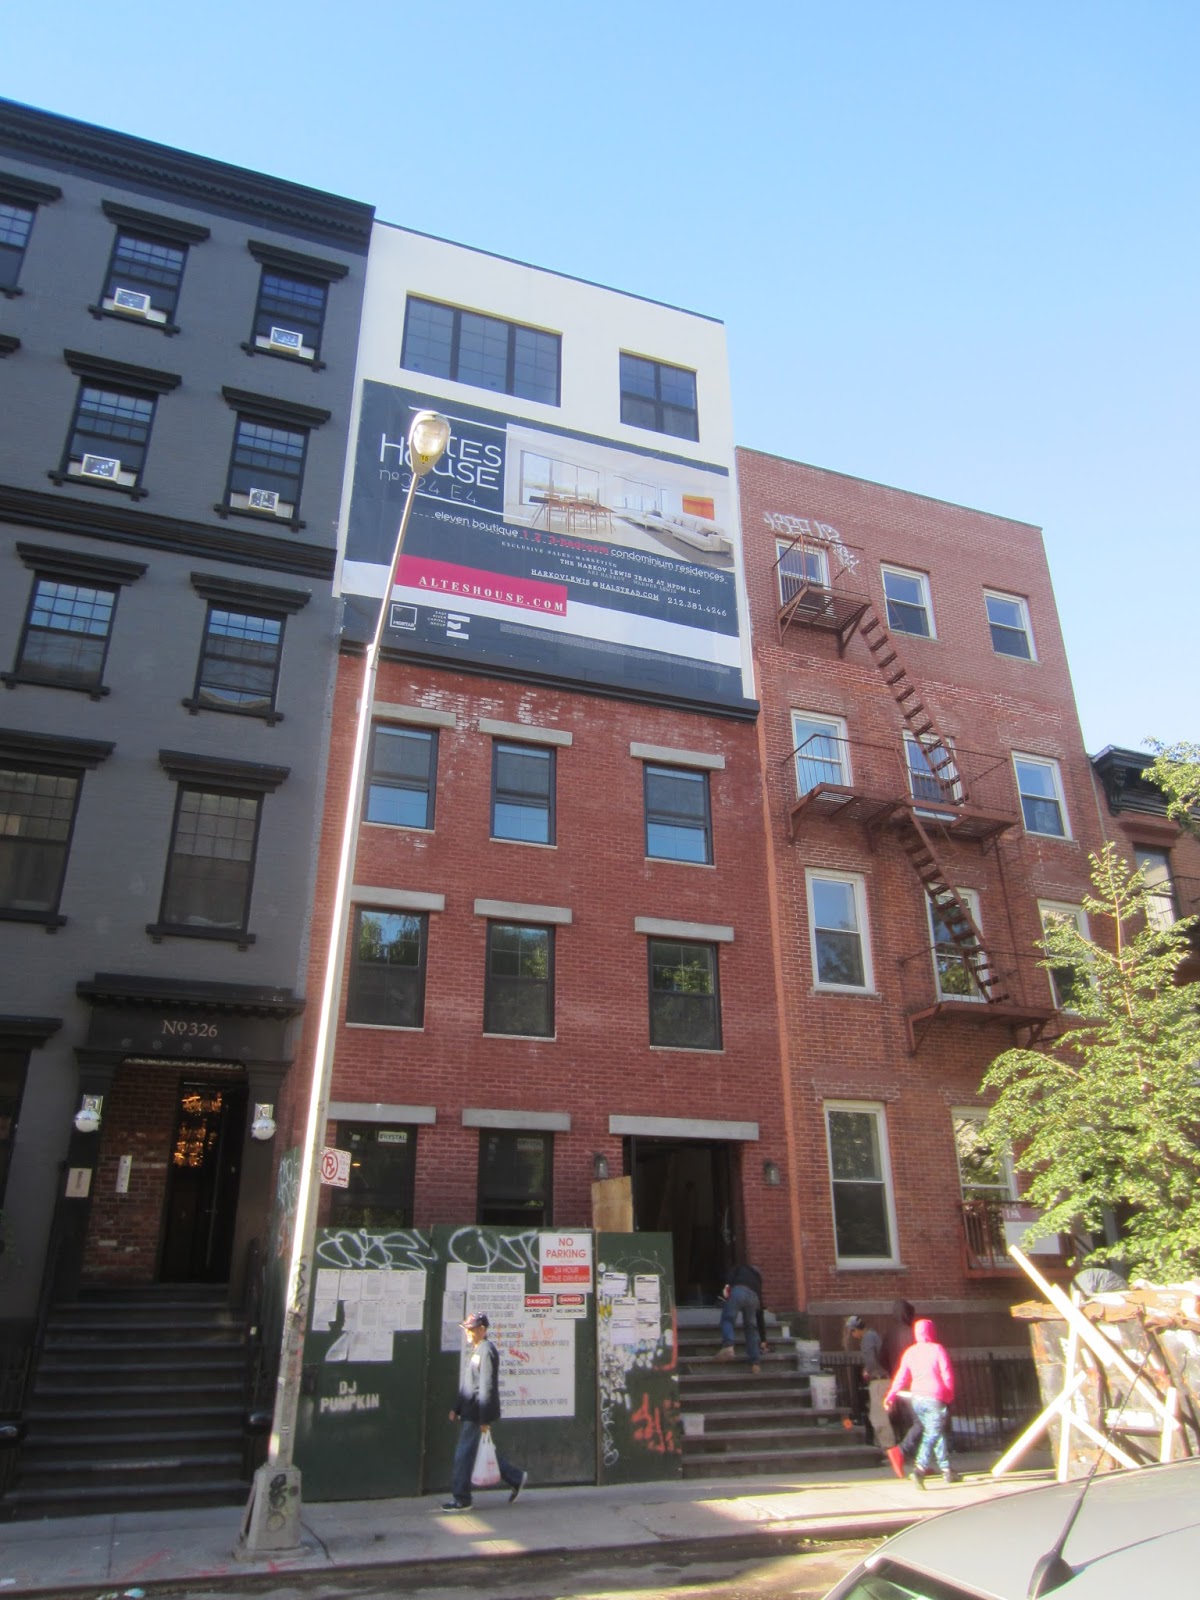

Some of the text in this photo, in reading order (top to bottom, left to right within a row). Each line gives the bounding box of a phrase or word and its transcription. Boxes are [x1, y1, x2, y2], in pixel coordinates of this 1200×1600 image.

[434, 511, 470, 527] eleven
[472, 518, 519, 540] boutique
[611, 549, 674, 570] condominium
[502, 541, 544, 554] EXCLUSIVE
[560, 558, 575, 567] THE
[577, 562, 607, 574] HARKOV
[610, 568, 632, 578] LEWIS
[634, 574, 655, 584] TEAM
[418, 575, 564, 612] ALTESHOUSE.COM
[558, 1237, 574, 1247] NO
[546, 1249, 586, 1259] PARKING
[554, 1266, 579, 1274] 24 HOUR
[339, 1380, 357, 1395] DJ
[320, 1393, 380, 1413] PUMPKIN
